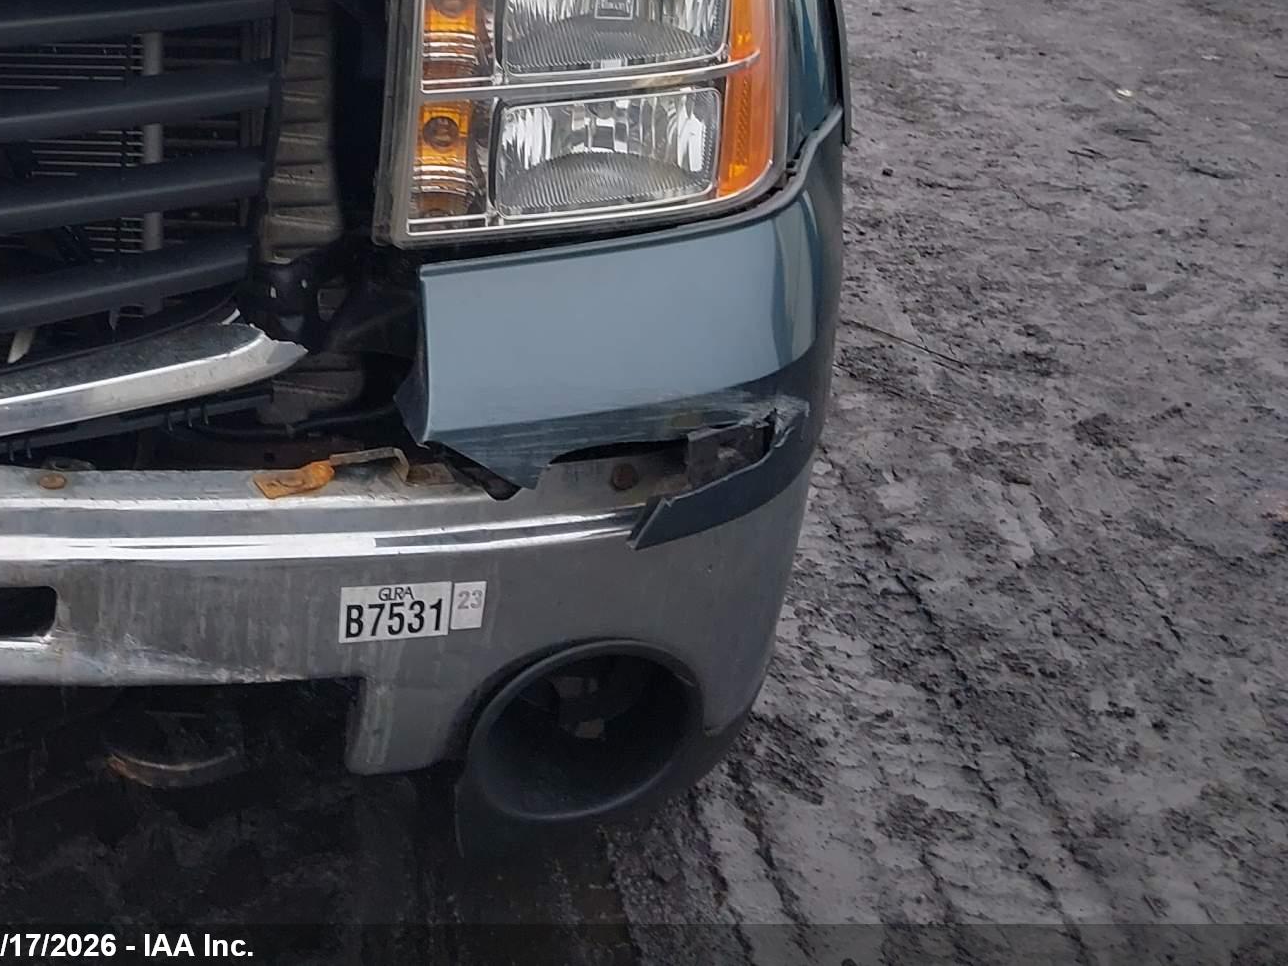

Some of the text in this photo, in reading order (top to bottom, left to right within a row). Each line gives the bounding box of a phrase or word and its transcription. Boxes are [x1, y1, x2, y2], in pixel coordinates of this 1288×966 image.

[378, 586, 415, 601] GLRA
[457, 590, 483, 610] 23
[345, 598, 443, 638] B7531
